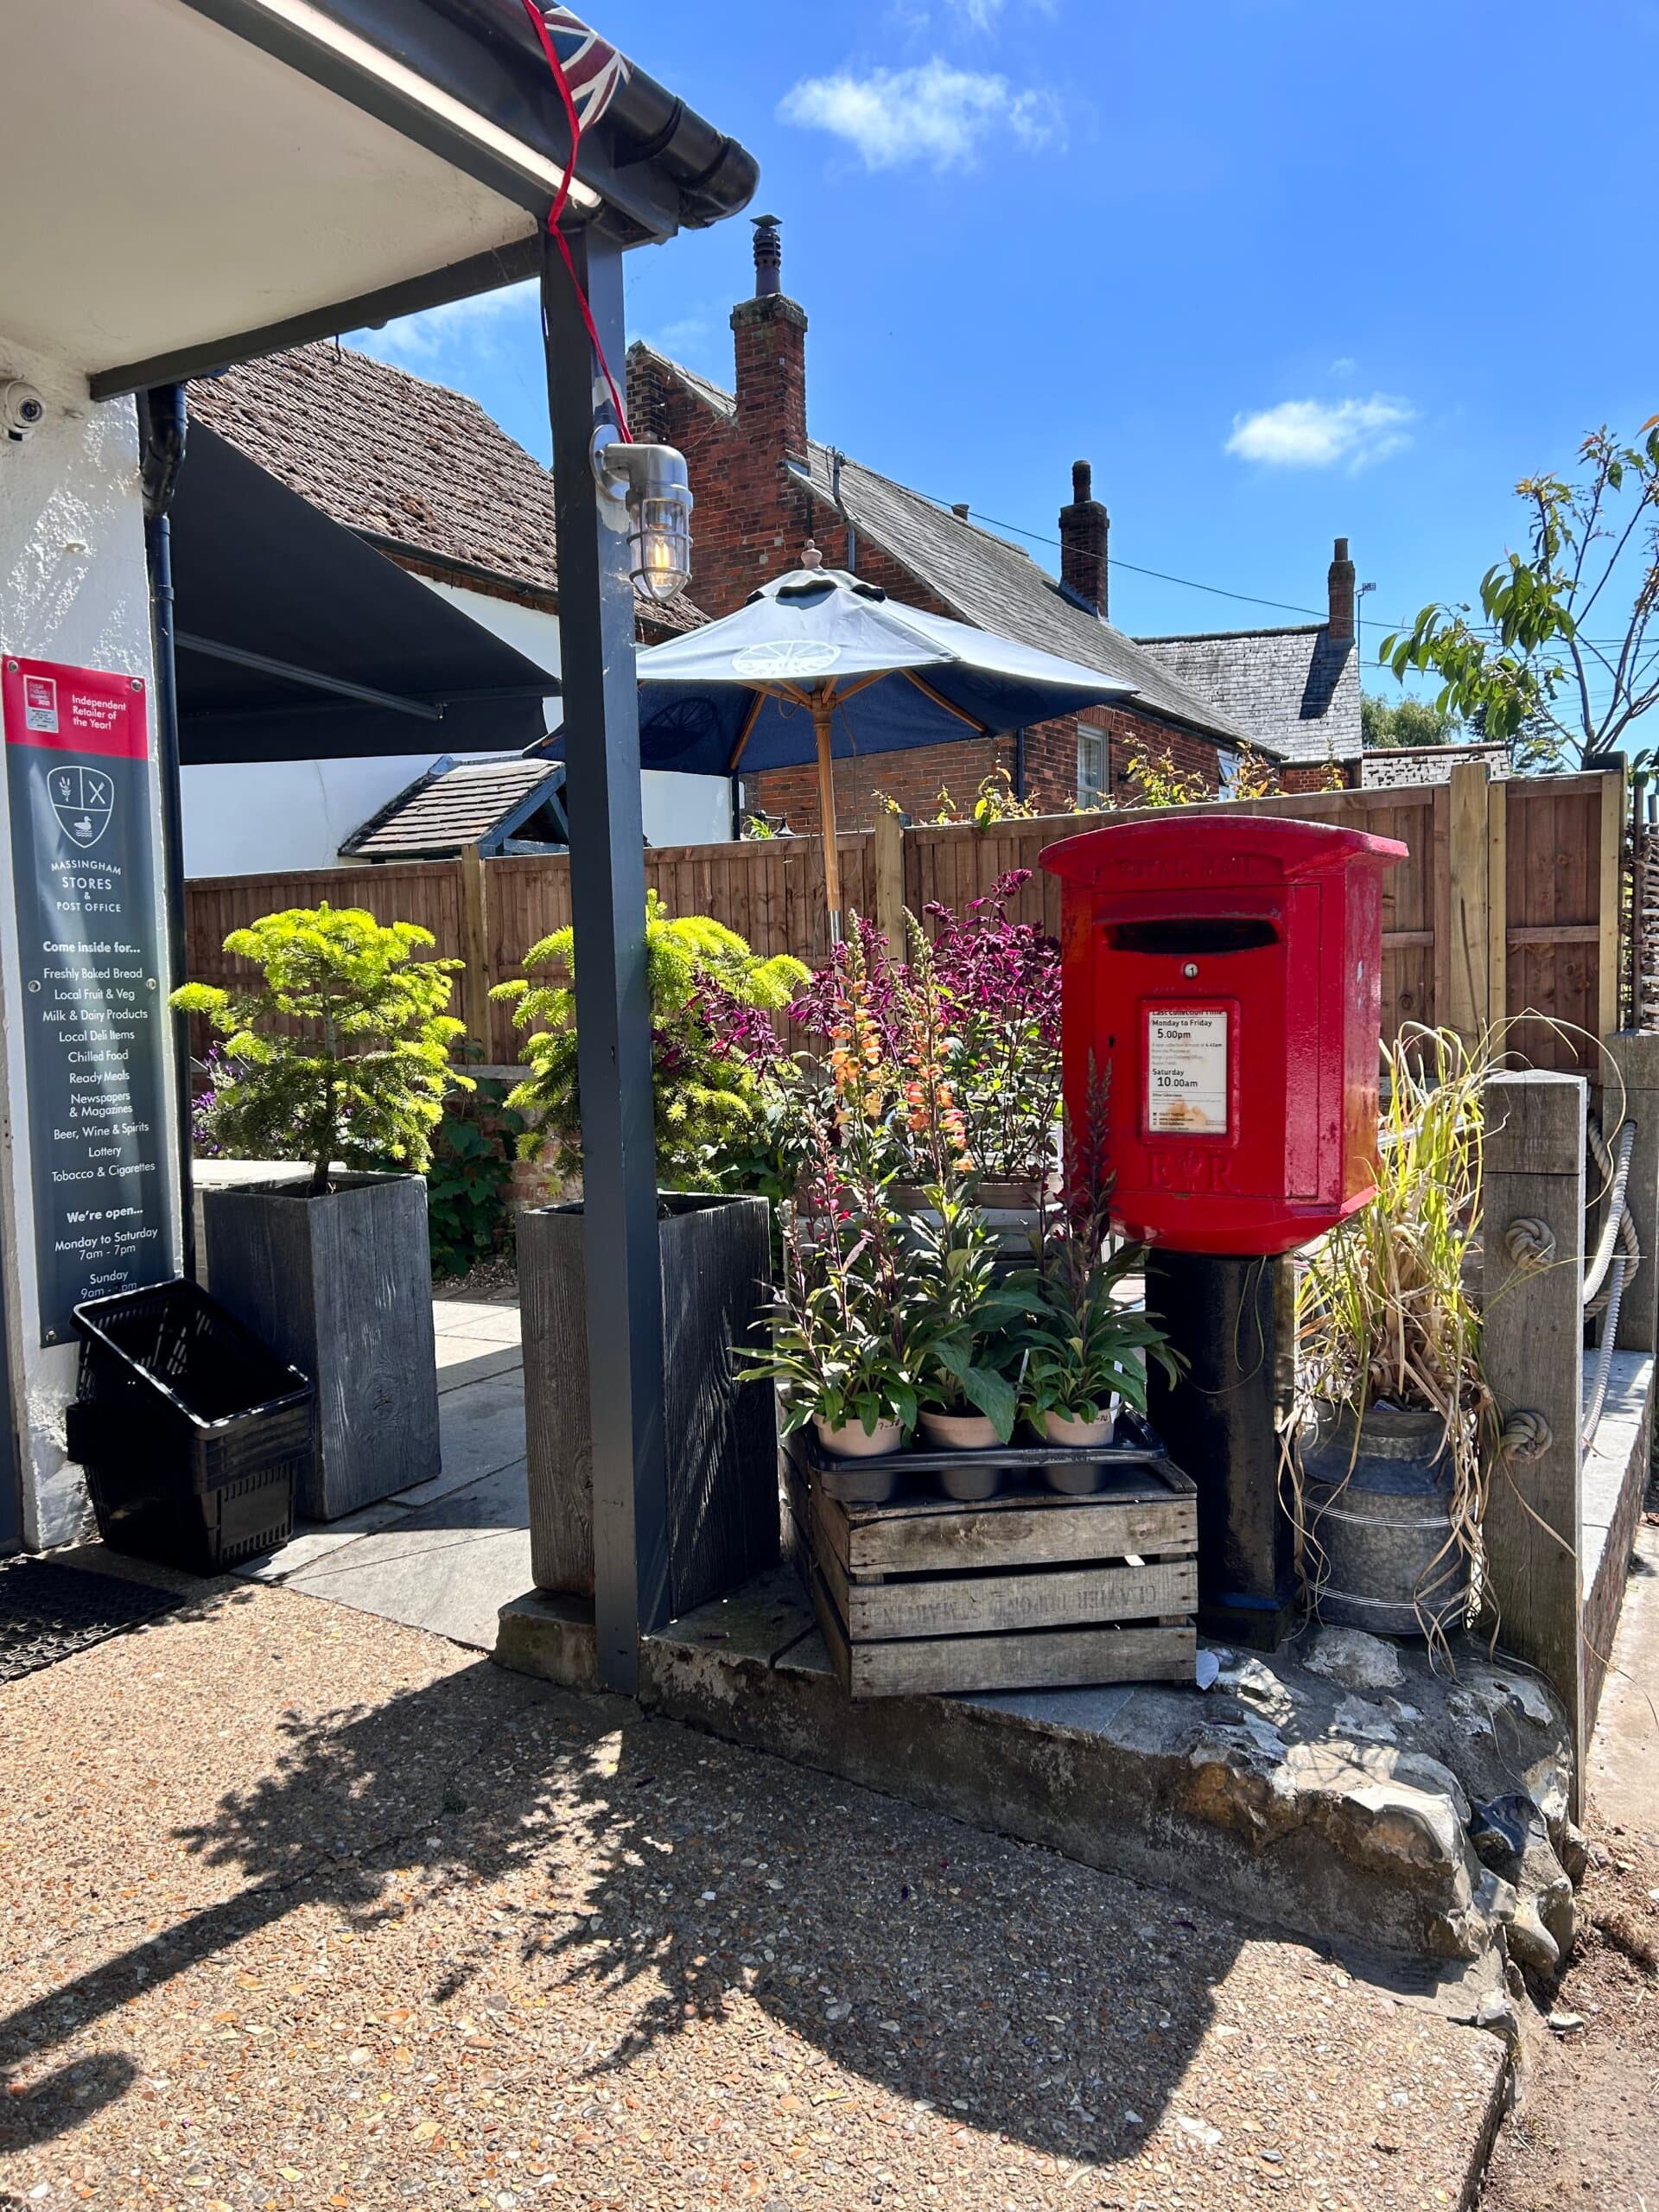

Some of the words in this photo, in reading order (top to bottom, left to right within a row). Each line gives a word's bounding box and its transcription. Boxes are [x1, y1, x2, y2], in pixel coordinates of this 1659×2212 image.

[72, 694, 126, 710] Independent
[73, 706, 105, 718] Retailer
[108, 711, 117, 720] of
[73, 716, 87, 727] the
[90, 718, 111, 730] Year!
[51, 860, 121, 875] MASSINGHAM
[61, 876, 111, 890] STORES
[84, 891, 91, 899] &
[56, 901, 81, 912] POST
[85, 903, 121, 912] OFFICE
[43, 941, 75, 953] Come
[78, 941, 111, 953] inside
[114, 942, 141, 953] for...
[43, 968, 79, 982] Freshly
[82, 968, 110, 979] Baked
[114, 968, 143, 978] Bread
[54, 989, 81, 1000] Local
[84, 989, 104, 1000] Fruit
[105, 990, 114, 999] &
[116, 988, 136, 1001] Veg
[42, 1010, 66, 1021] Milk
[70, 1011, 78, 1020] &
[80, 1010, 105, 1022] Dairy
[107, 1009, 149, 1020] Products
[59, 1031, 87, 1042] Local
[90, 1030, 107, 1041] Deli
[110, 1030, 135, 1040] Items
[1157, 1028, 1191, 1039] 5.00pm
[67, 1051, 104, 1063] Chilled
[105, 1049, 129, 1060] Food
[69, 1072, 102, 1084] Ready
[104, 1070, 130, 1082] Meals
[1152, 1068, 1185, 1077] Saturday
[1157, 1077, 1198, 1087] 10.00am
[71, 1091, 130, 1105] Newspapers
[69, 1107, 78, 1117] &
[81, 1104, 133, 1118] Magazines
[54, 1128, 79, 1141] Beer,
[82, 1126, 110, 1137] Wine
[112, 1124, 120, 1135] &
[122, 1122, 150, 1135] Spirits
[88, 1147, 122, 1158] Lottery
[52, 1170, 94, 1182] Tobacco
[98, 1166, 105, 1177] &
[108, 1162, 156, 1178] Cigarettes
[67, 1210, 103, 1224] We're
[105, 1207, 143, 1220] open...
[54, 1236, 98, 1252] Monday
[100, 1234, 111, 1245] to
[114, 1227, 159, 1243] Saturday
[79, 1249, 103, 1262] 7am
[114, 1243, 136, 1256] 7pm
[90, 1269, 129, 1285] Sunday
[80, 1287, 105, 1300] 9am
